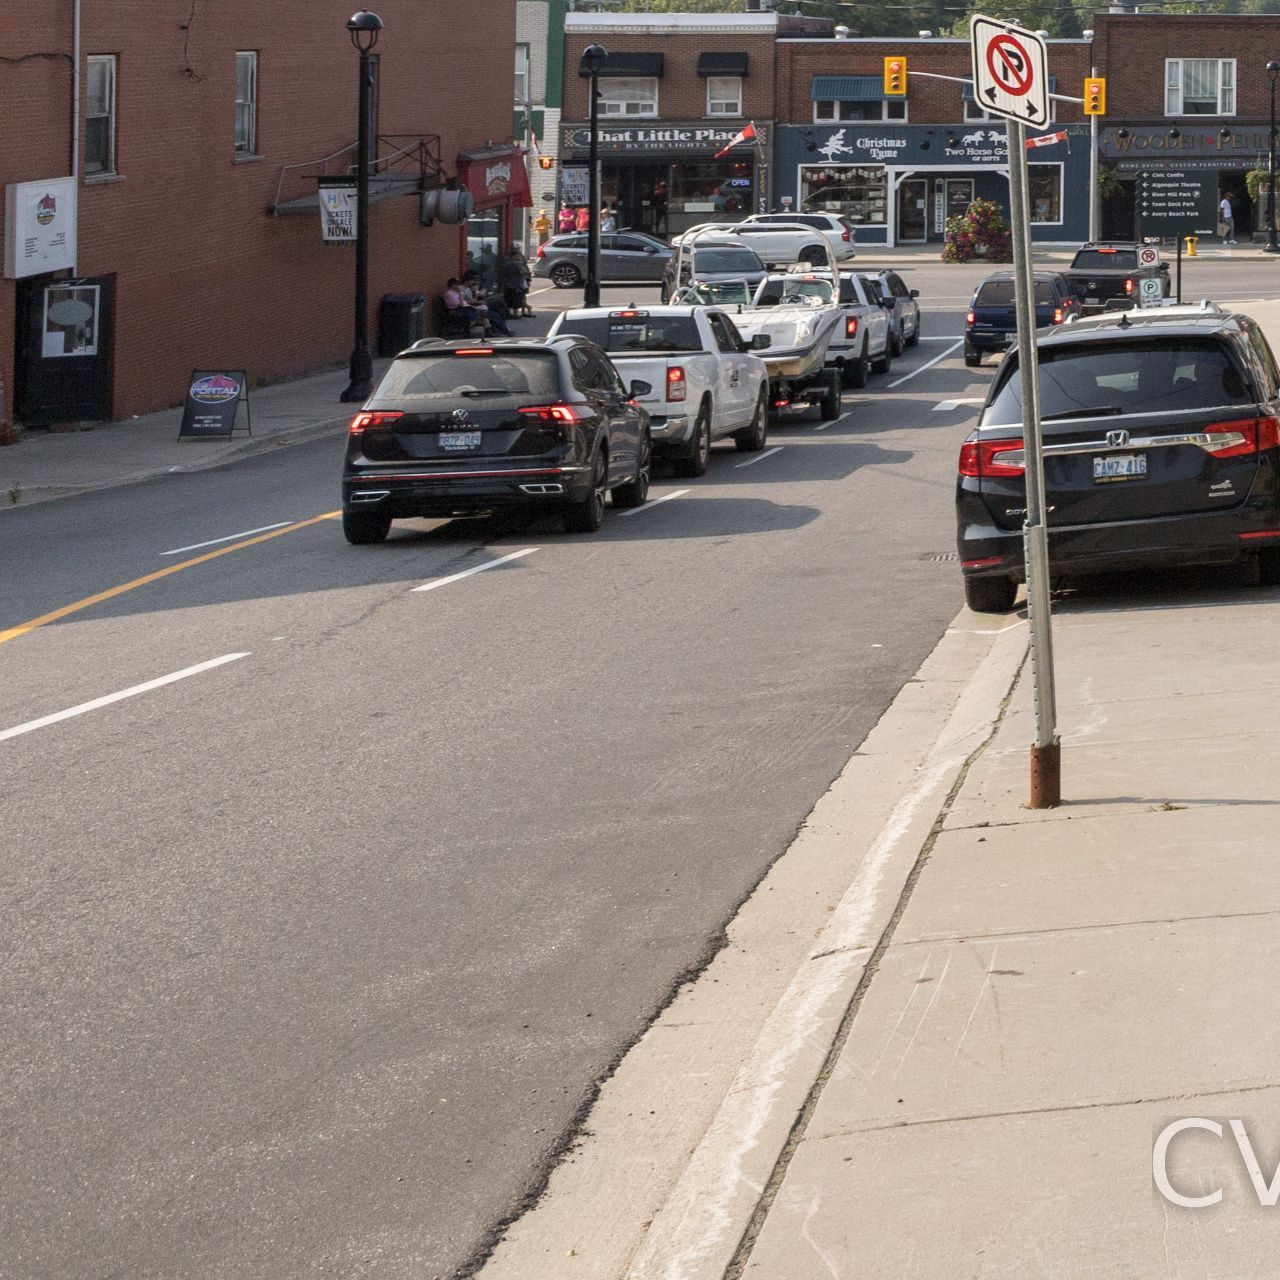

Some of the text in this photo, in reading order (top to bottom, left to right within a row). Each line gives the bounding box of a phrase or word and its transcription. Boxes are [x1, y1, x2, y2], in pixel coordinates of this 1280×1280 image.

[638, 129, 692, 142] Little
[695, 129, 739, 142] Plac
[856, 137, 907, 149] Christmas
[869, 148, 898, 160] Tyme
[944, 147, 965, 156] Two
[966, 147, 993, 156] Horse
[327, 226, 353, 237] NOW!
